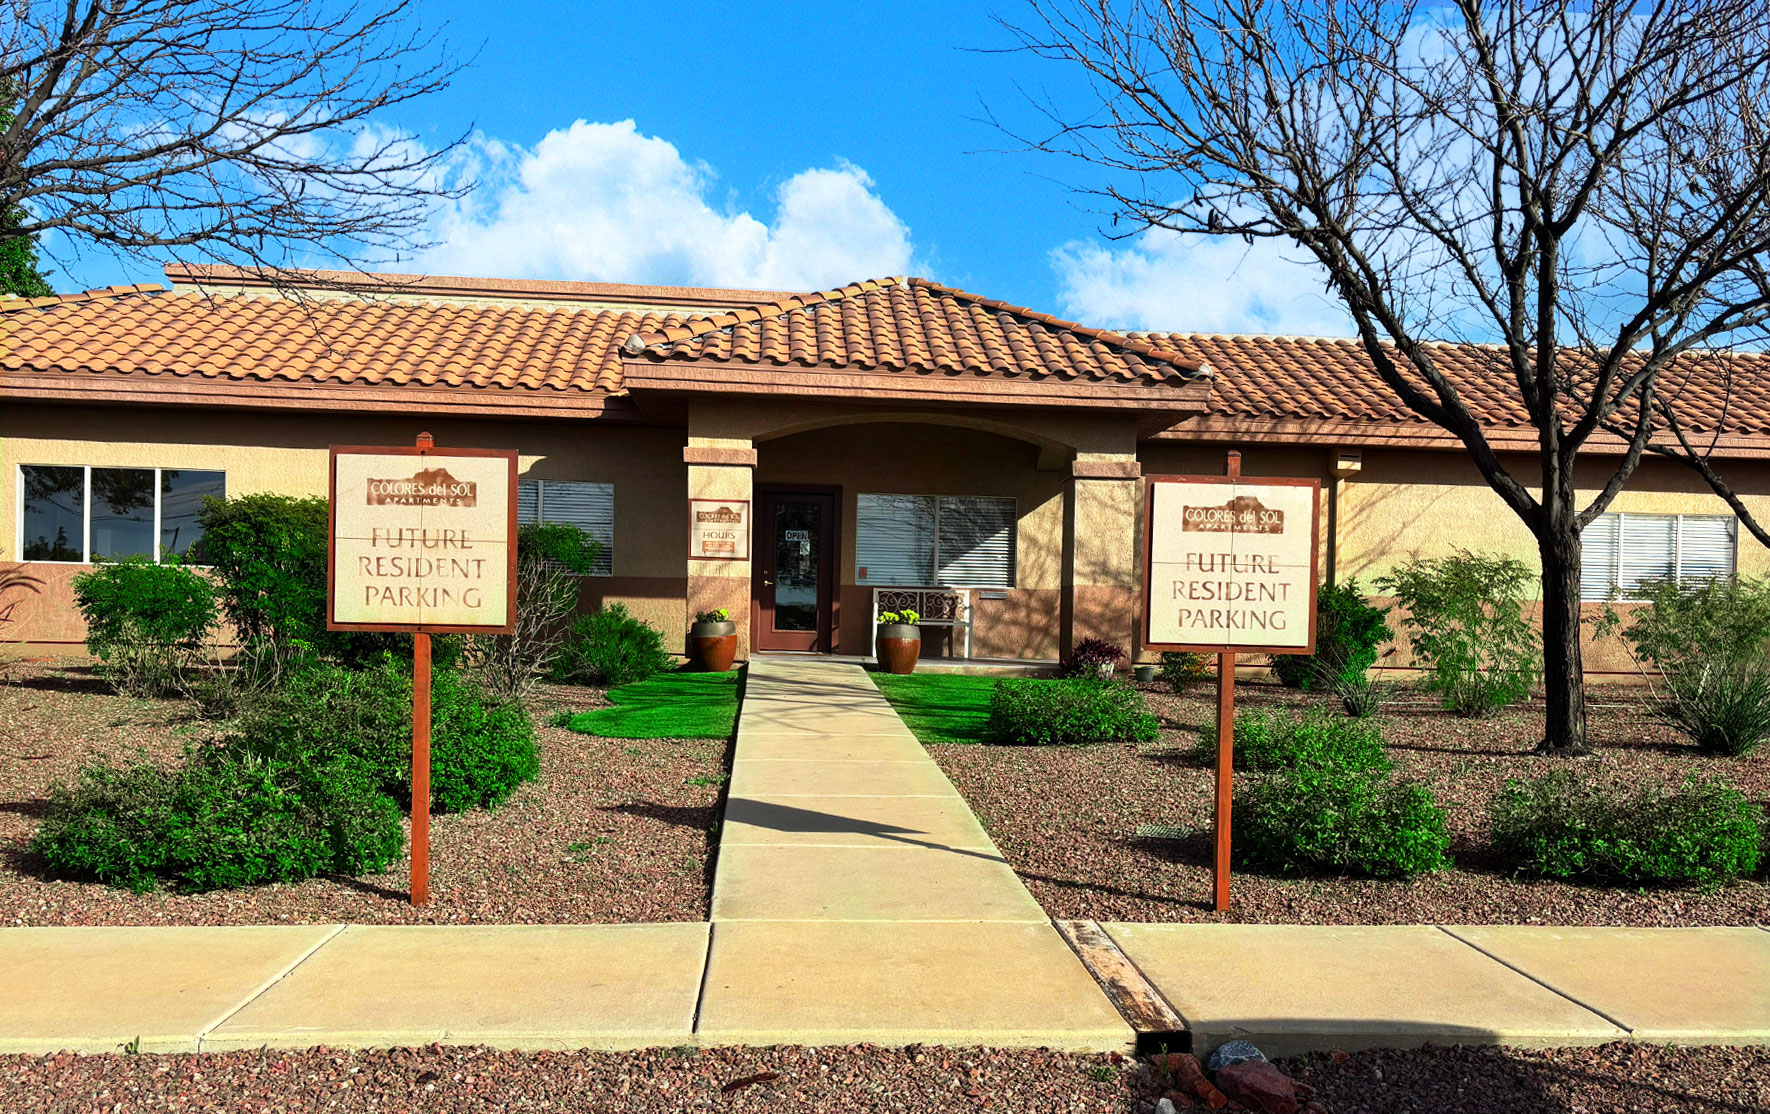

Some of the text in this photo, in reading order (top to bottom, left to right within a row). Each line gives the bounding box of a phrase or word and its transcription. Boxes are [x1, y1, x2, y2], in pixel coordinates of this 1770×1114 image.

[370, 482, 473, 497] COLORES del SOL
[1185, 509, 1281, 524] COLORES del SOL
[372, 528, 473, 549] FUTURE
[703, 531, 736, 539] HOURS
[786, 531, 808, 540] OPEN
[358, 556, 486, 579] RESIDENT
[1186, 553, 1280, 574] FUTURE
[365, 586, 481, 608] PARKING
[1172, 580, 1291, 602] RESIDENT
[1178, 608, 1286, 630] PARKING
